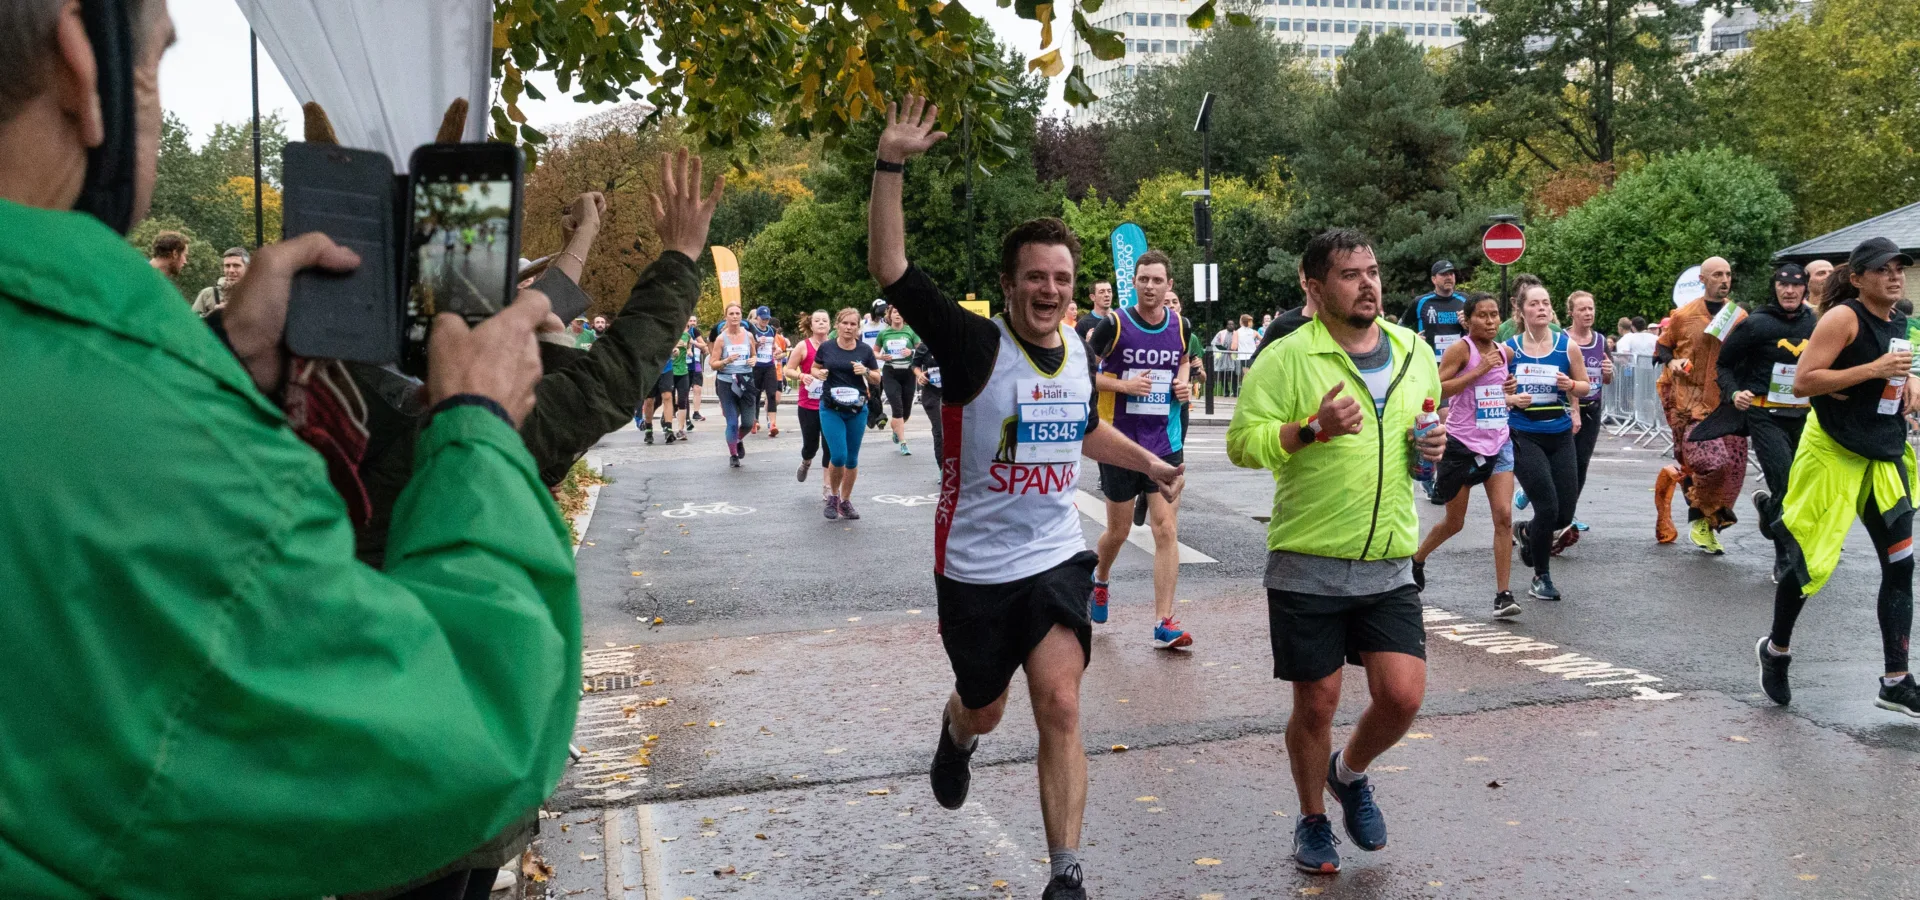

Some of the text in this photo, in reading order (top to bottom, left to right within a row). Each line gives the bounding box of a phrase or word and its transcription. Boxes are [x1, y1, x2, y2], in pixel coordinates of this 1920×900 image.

[1116, 267, 1132, 309] actio
[1122, 348, 1180, 366] SCOPE
[1043, 389, 1062, 399] Half
[1032, 406, 1068, 418] CHRIS
[1028, 422, 1078, 441] 15345
[936, 457, 958, 527] SPANA
